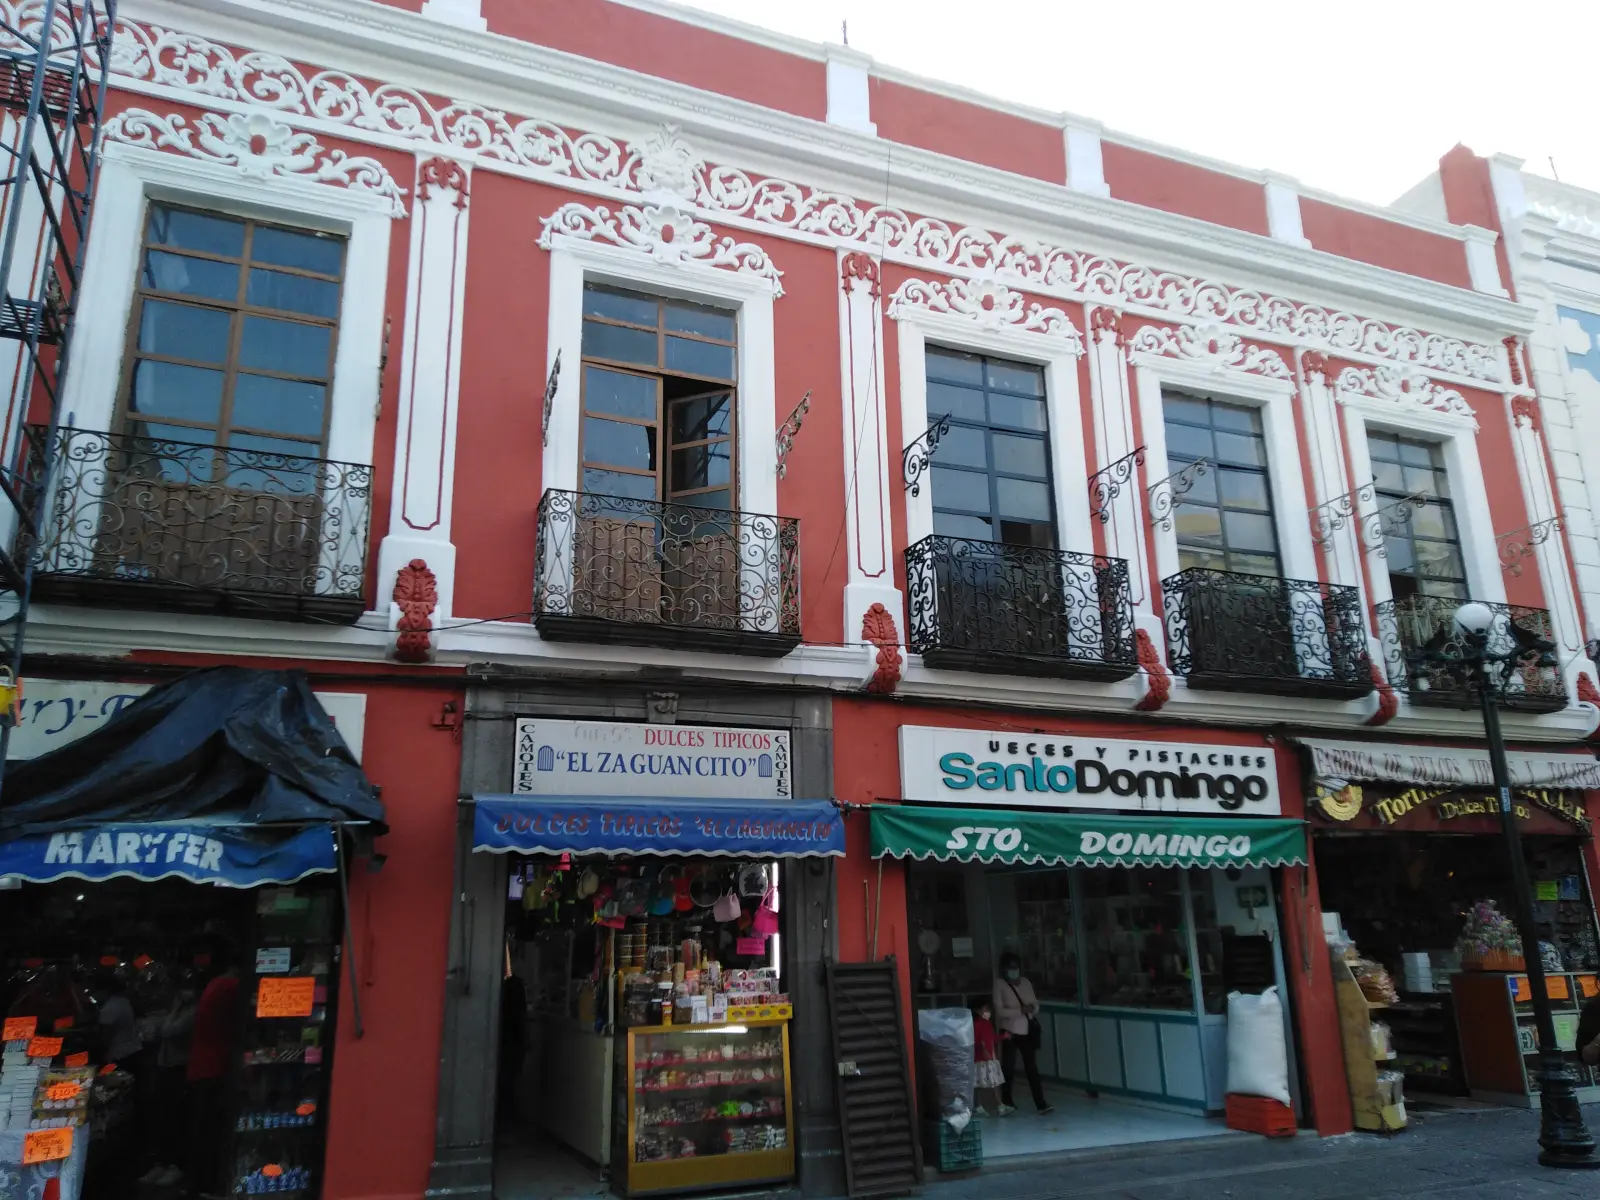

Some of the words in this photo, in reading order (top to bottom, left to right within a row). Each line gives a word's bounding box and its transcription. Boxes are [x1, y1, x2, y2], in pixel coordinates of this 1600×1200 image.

[644, 729, 705, 747] DULCES
[712, 731, 771, 750] TIPICOS
[519, 724, 535, 792] CAMOTES
[774, 735, 788, 797] CAMOTES
[989, 741, 1073, 757] UECES
[1096, 747, 1107, 759] Y
[1128, 749, 1267, 769] PISTACHES
[1406, 755, 1464, 783] DULCES
[946, 827, 1029, 852] STO.
[1079, 831, 1251, 857] DOMINGO
